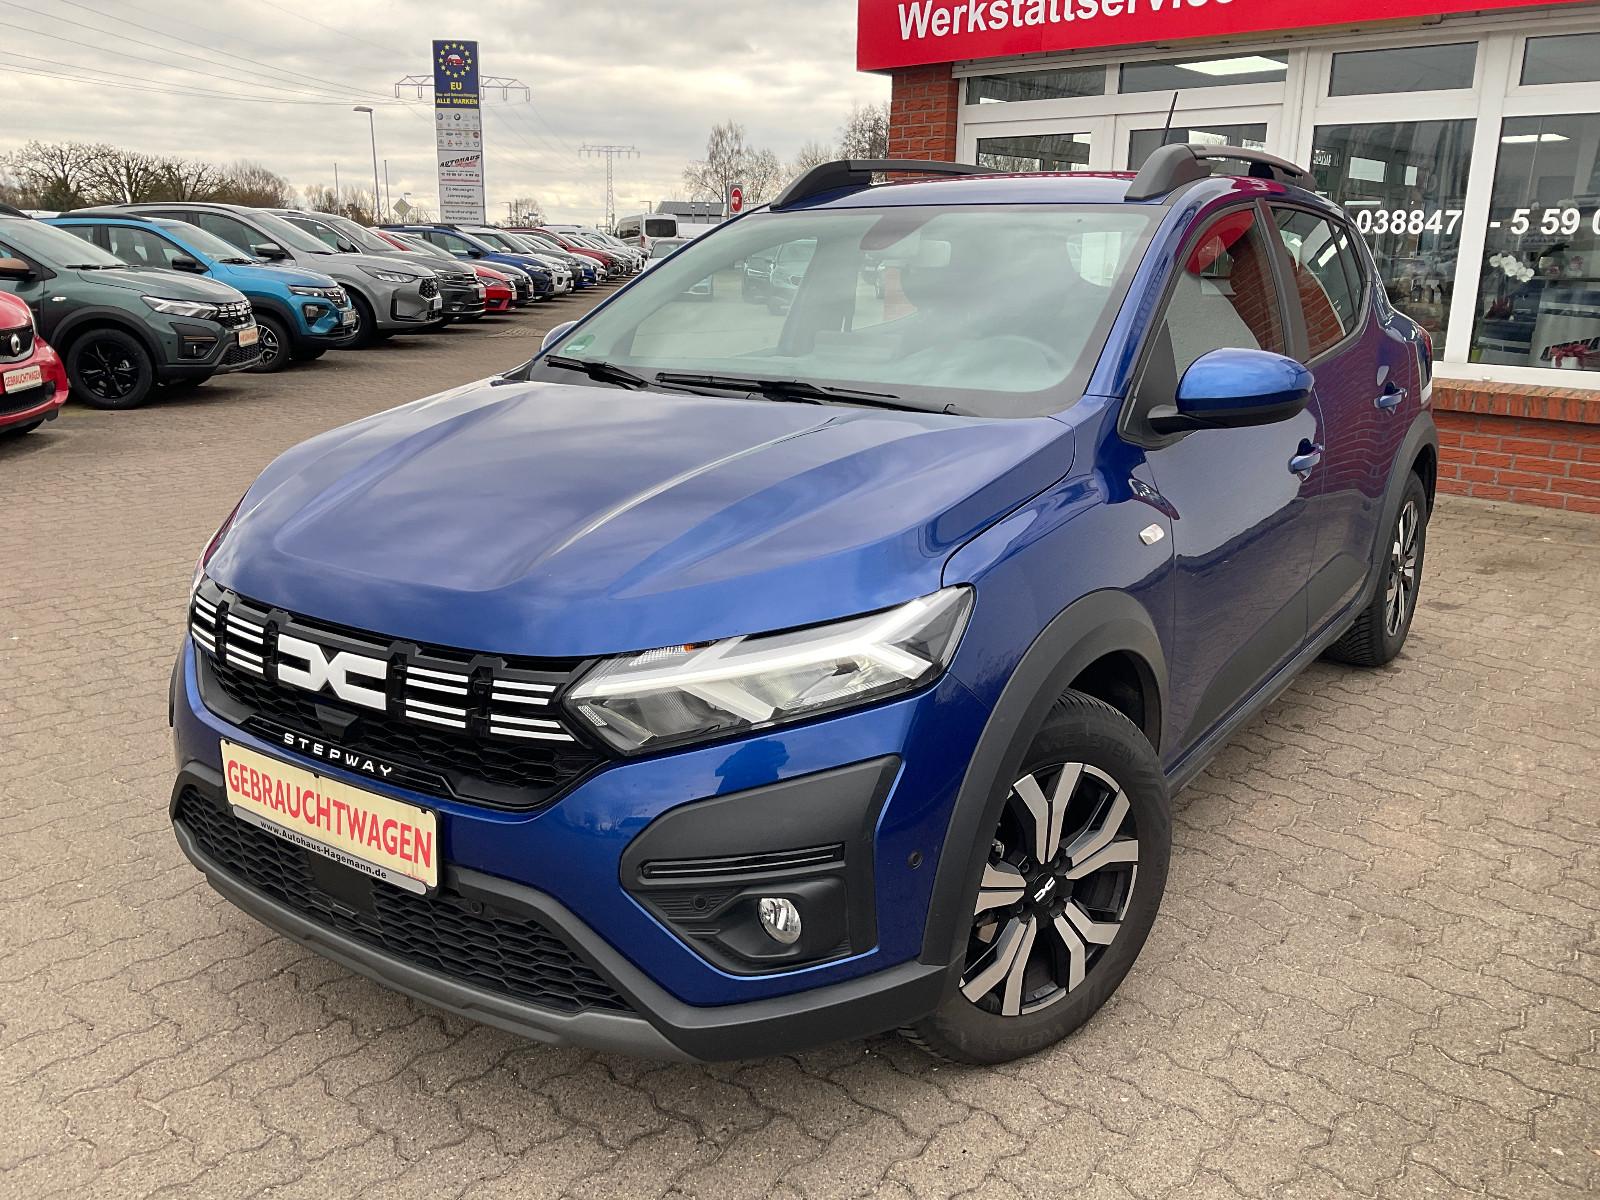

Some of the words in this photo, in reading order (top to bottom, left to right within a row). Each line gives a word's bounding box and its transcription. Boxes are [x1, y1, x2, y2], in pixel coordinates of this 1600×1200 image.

[898, 0, 1233, 41] Werkstattse
[450, 81, 462, 90] EU
[440, 154, 481, 168] AUTOHAUS
[1356, 209, 1463, 235] 038847
[1541, 208, 1581, 235] 59
[284, 732, 393, 777] STEPWAY
[227, 759, 432, 869] GEBRAUCHTWAGEN
[260, 819, 387, 879] www.Autohaus-Hagemann.de
